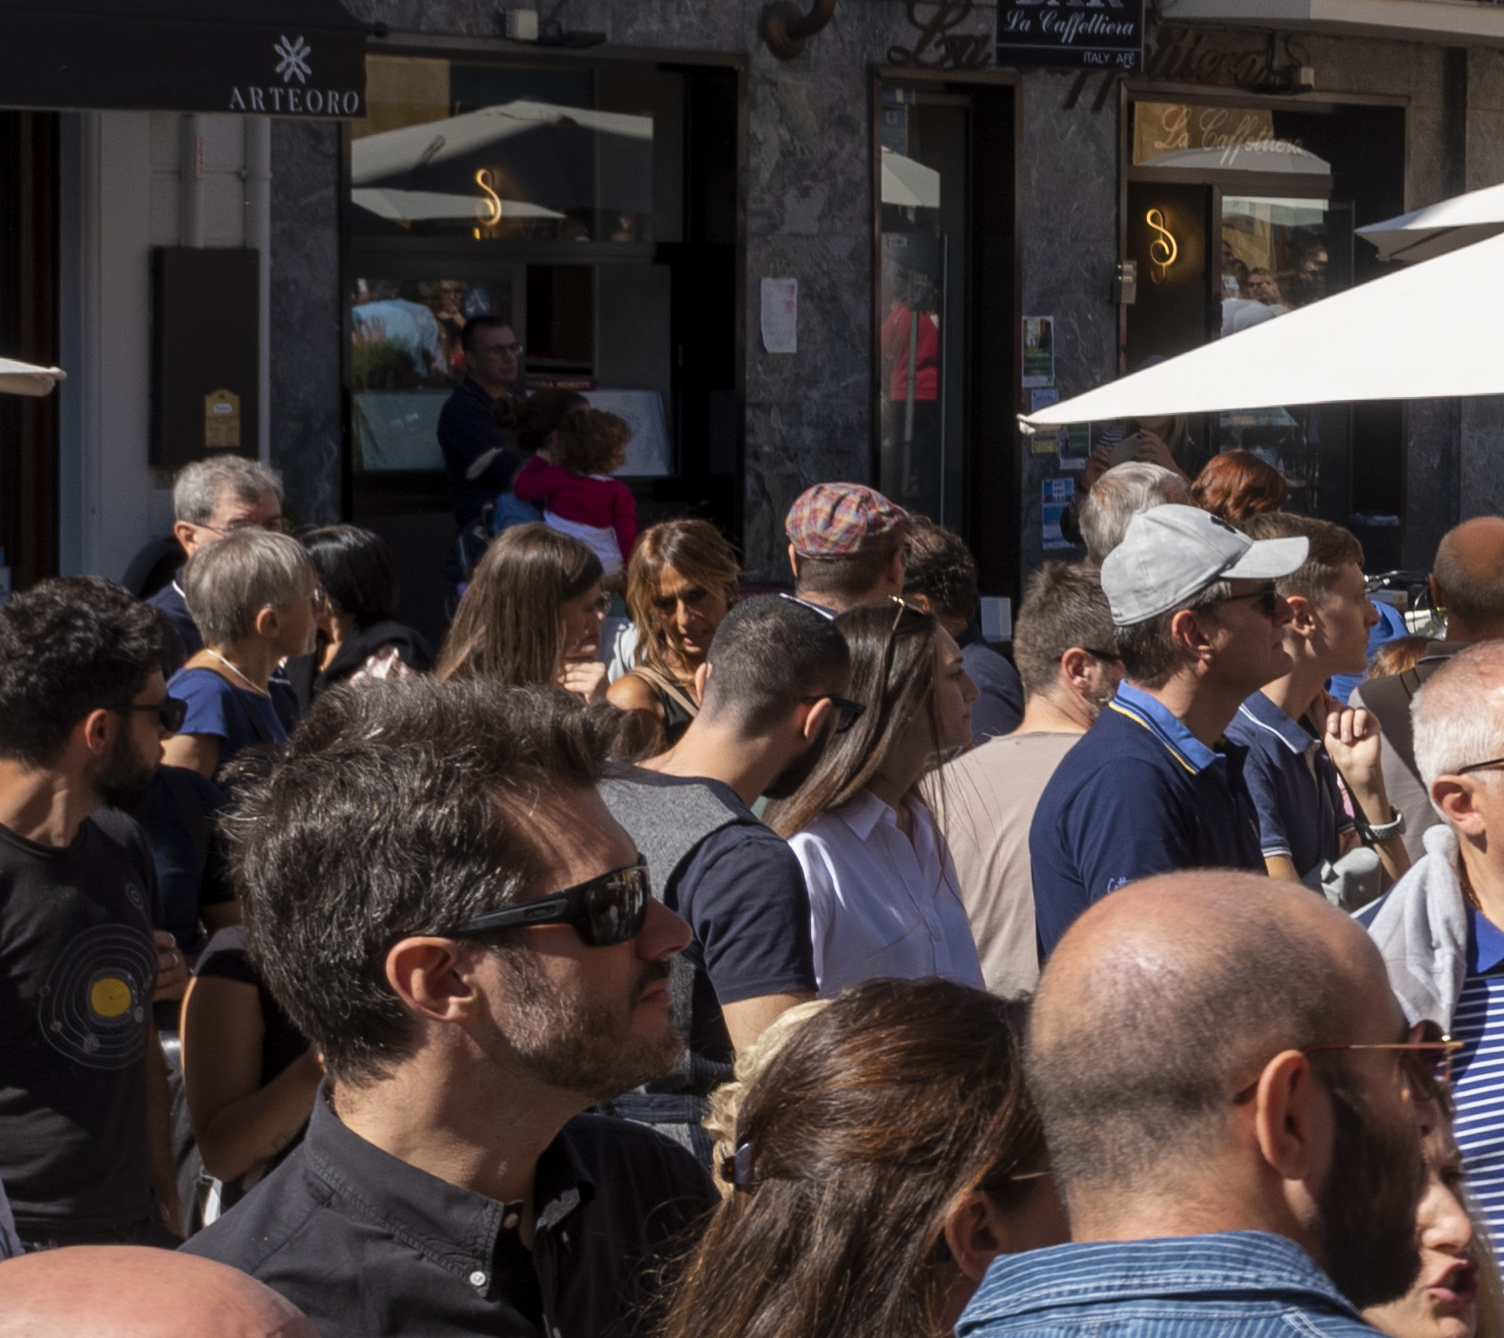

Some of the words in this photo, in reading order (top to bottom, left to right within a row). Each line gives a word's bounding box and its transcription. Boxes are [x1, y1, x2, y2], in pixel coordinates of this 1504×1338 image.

[1004, 9, 1031, 32] La
[1040, 9, 1135, 44] Caffettiera
[1083, 51, 1111, 65] ITALY
[229, 85, 360, 115] ARTEORO
[1153, 106, 1190, 150] La
[1199, 108, 1303, 166] Caffettiera
